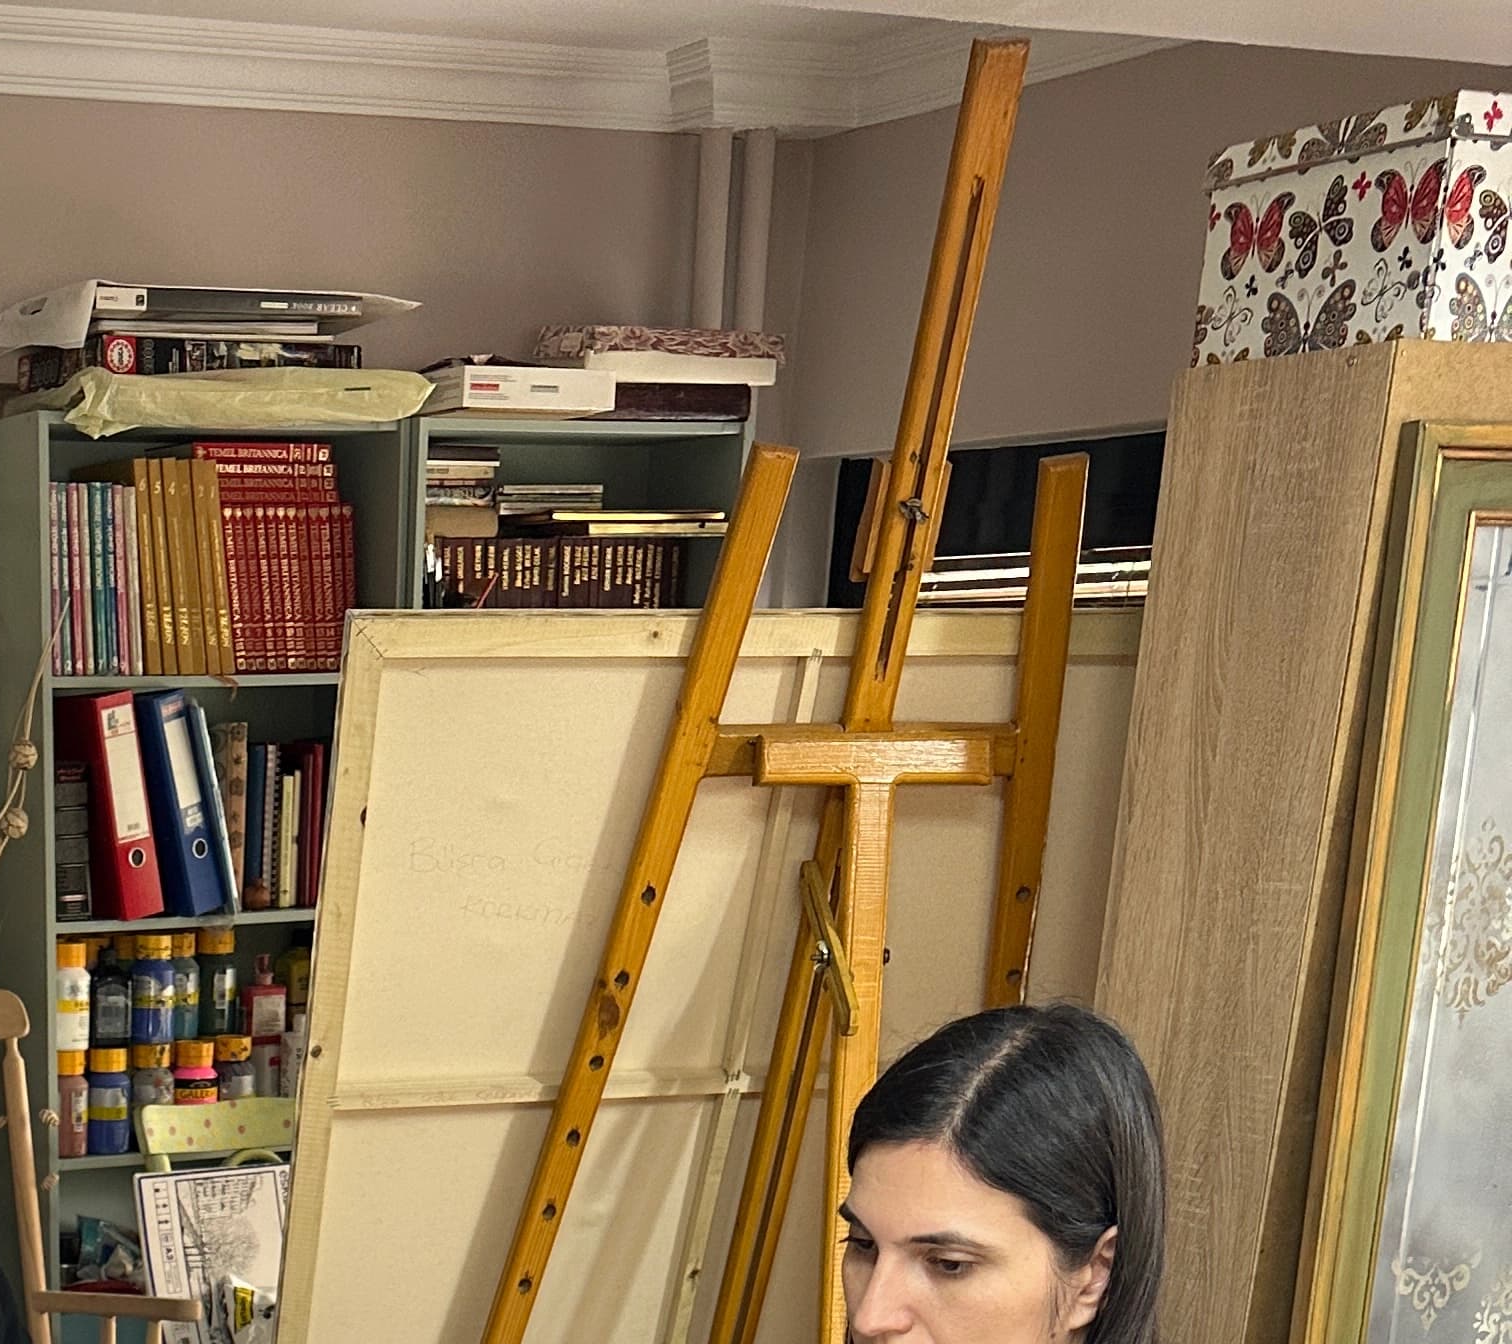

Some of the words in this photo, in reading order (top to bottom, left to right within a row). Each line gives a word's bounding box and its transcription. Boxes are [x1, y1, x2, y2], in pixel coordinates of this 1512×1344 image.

[208, 448, 236, 457] TEMEL
[238, 448, 288, 458] BRITANNICA
[243, 464, 293, 474] BRITANNICA
[221, 479, 243, 487] EMEL
[244, 478, 293, 488] BRITANNICA
[225, 522, 234, 558] TEMEL
[257, 522, 267, 558] TEMEL
[267, 522, 277, 558] TEMEL
[278, 522, 287, 558] TEMEL
[287, 522, 297, 558] TEMEL
[311, 522, 320, 558] TEMEL
[320, 522, 330, 558] TEMEL
[227, 559, 241, 620] BRITANNICA
[260, 559, 272, 620] BRITANNICA
[270, 559, 282, 620] BRITANNICA
[281, 559, 293, 620] BRITANNICA
[291, 559, 303, 620] BRITANNICA
[312, 559, 325, 620] BRITANNICA
[323, 559, 335, 620] BRITANNICA
